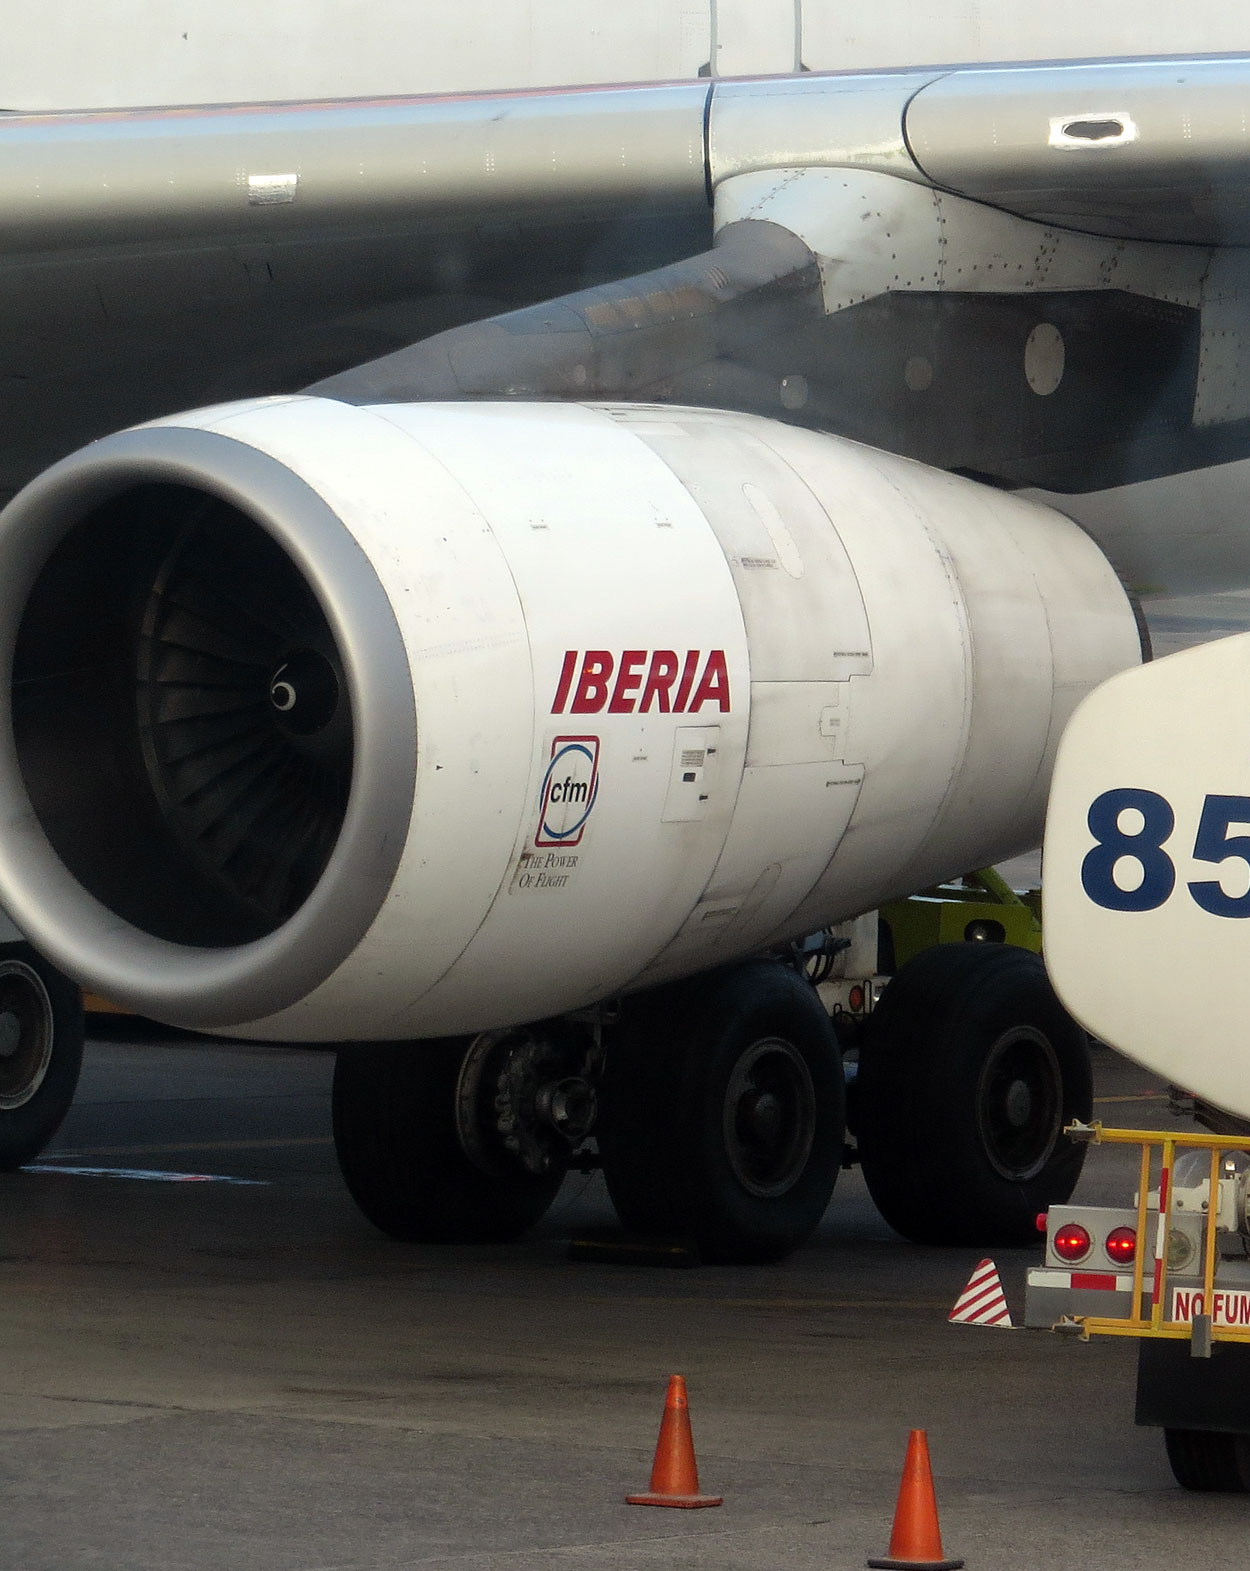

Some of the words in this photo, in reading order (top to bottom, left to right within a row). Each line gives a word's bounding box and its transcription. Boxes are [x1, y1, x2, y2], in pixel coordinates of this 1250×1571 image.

[550, 649, 731, 715] IBERIA
[550, 777, 588, 804] cfm
[1175, 1291, 1206, 1322] NO
